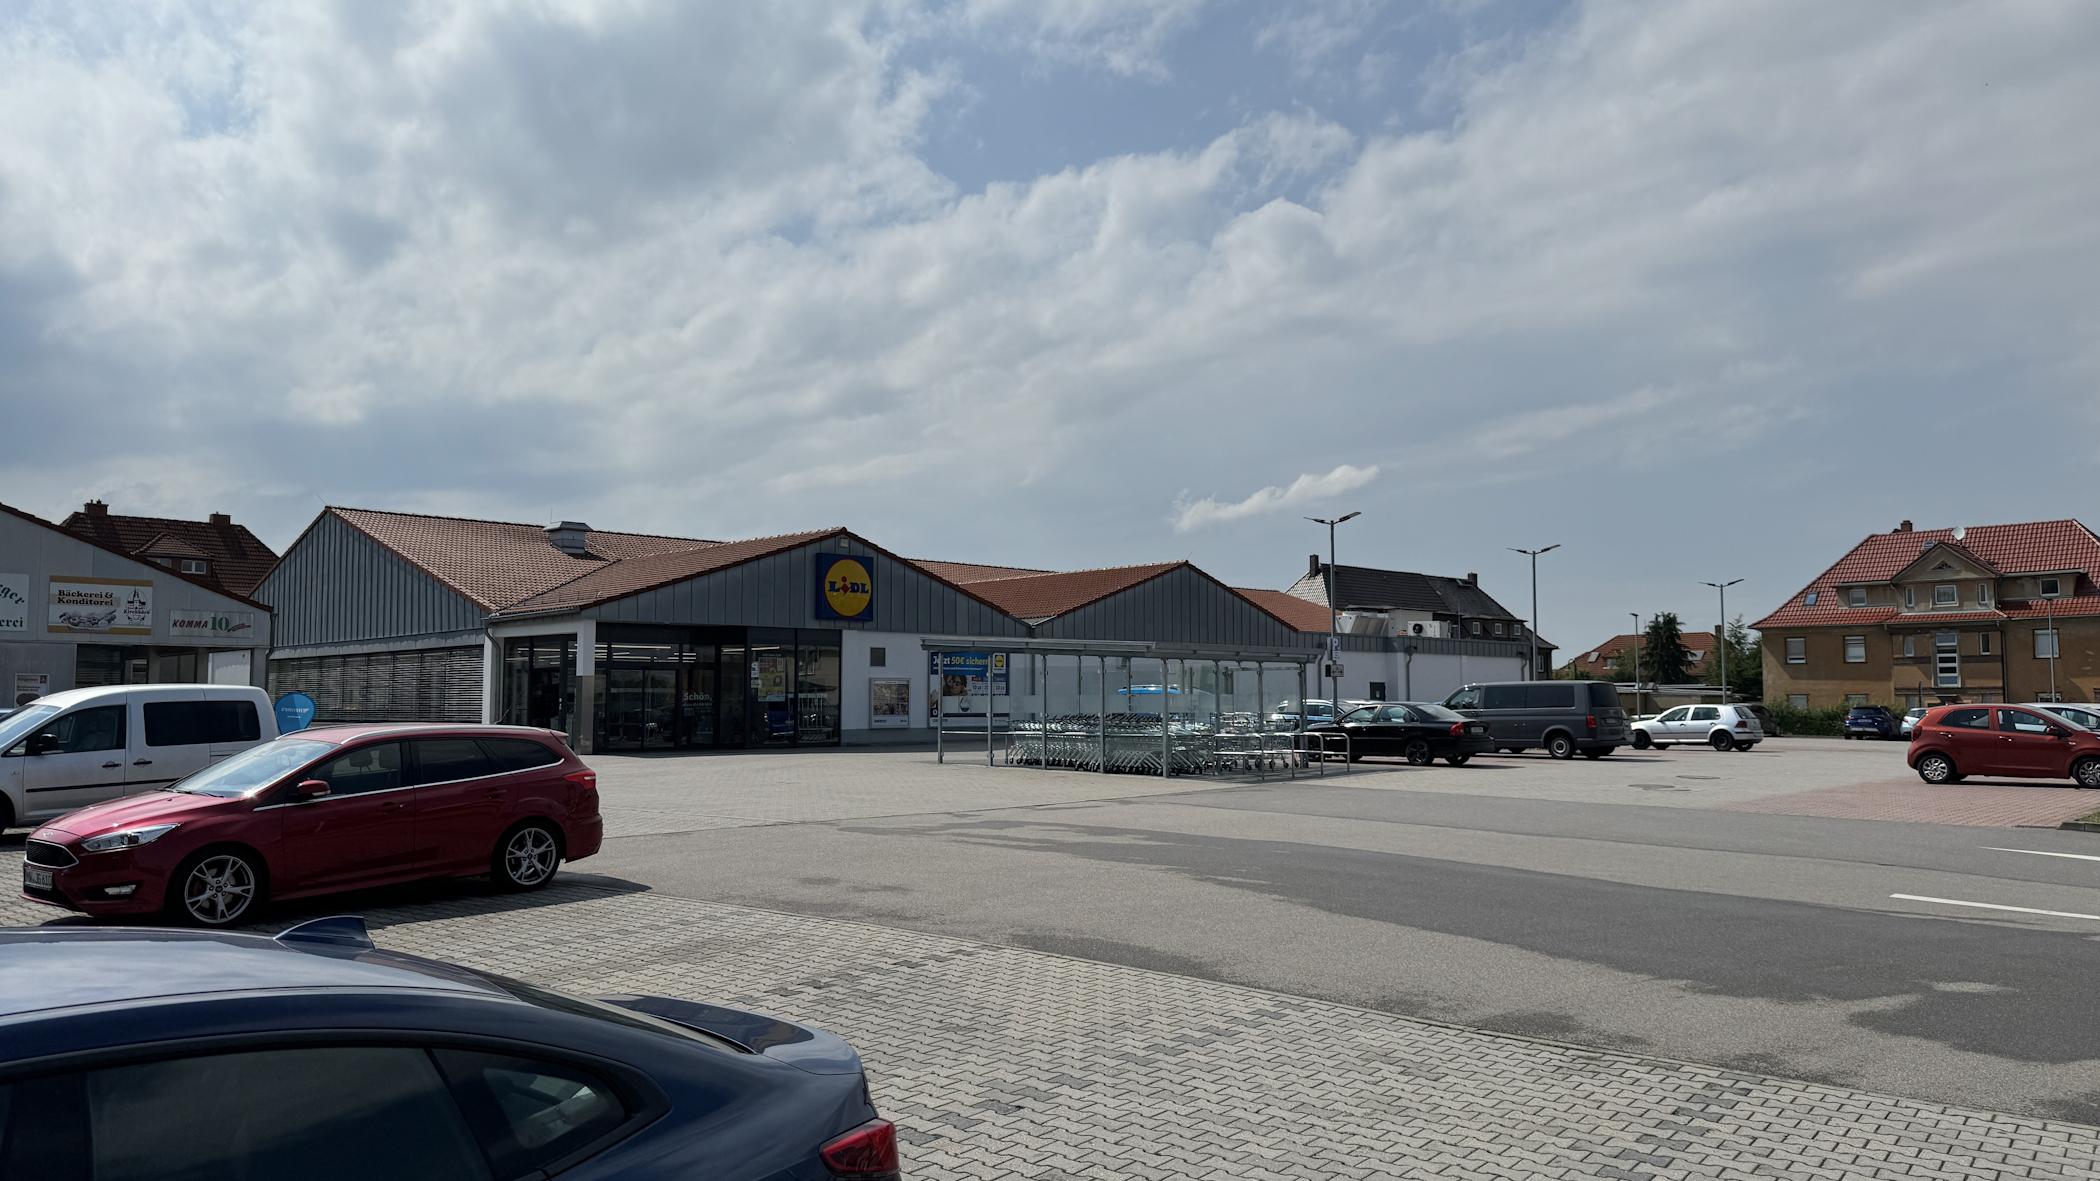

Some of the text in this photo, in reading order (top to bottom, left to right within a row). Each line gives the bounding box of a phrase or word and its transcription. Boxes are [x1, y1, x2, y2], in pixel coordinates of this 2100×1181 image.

[58, 589, 114, 599] Bäckerei &
[57, 597, 114, 607] Konditorei
[172, 616, 230, 631] KOMMA 10
